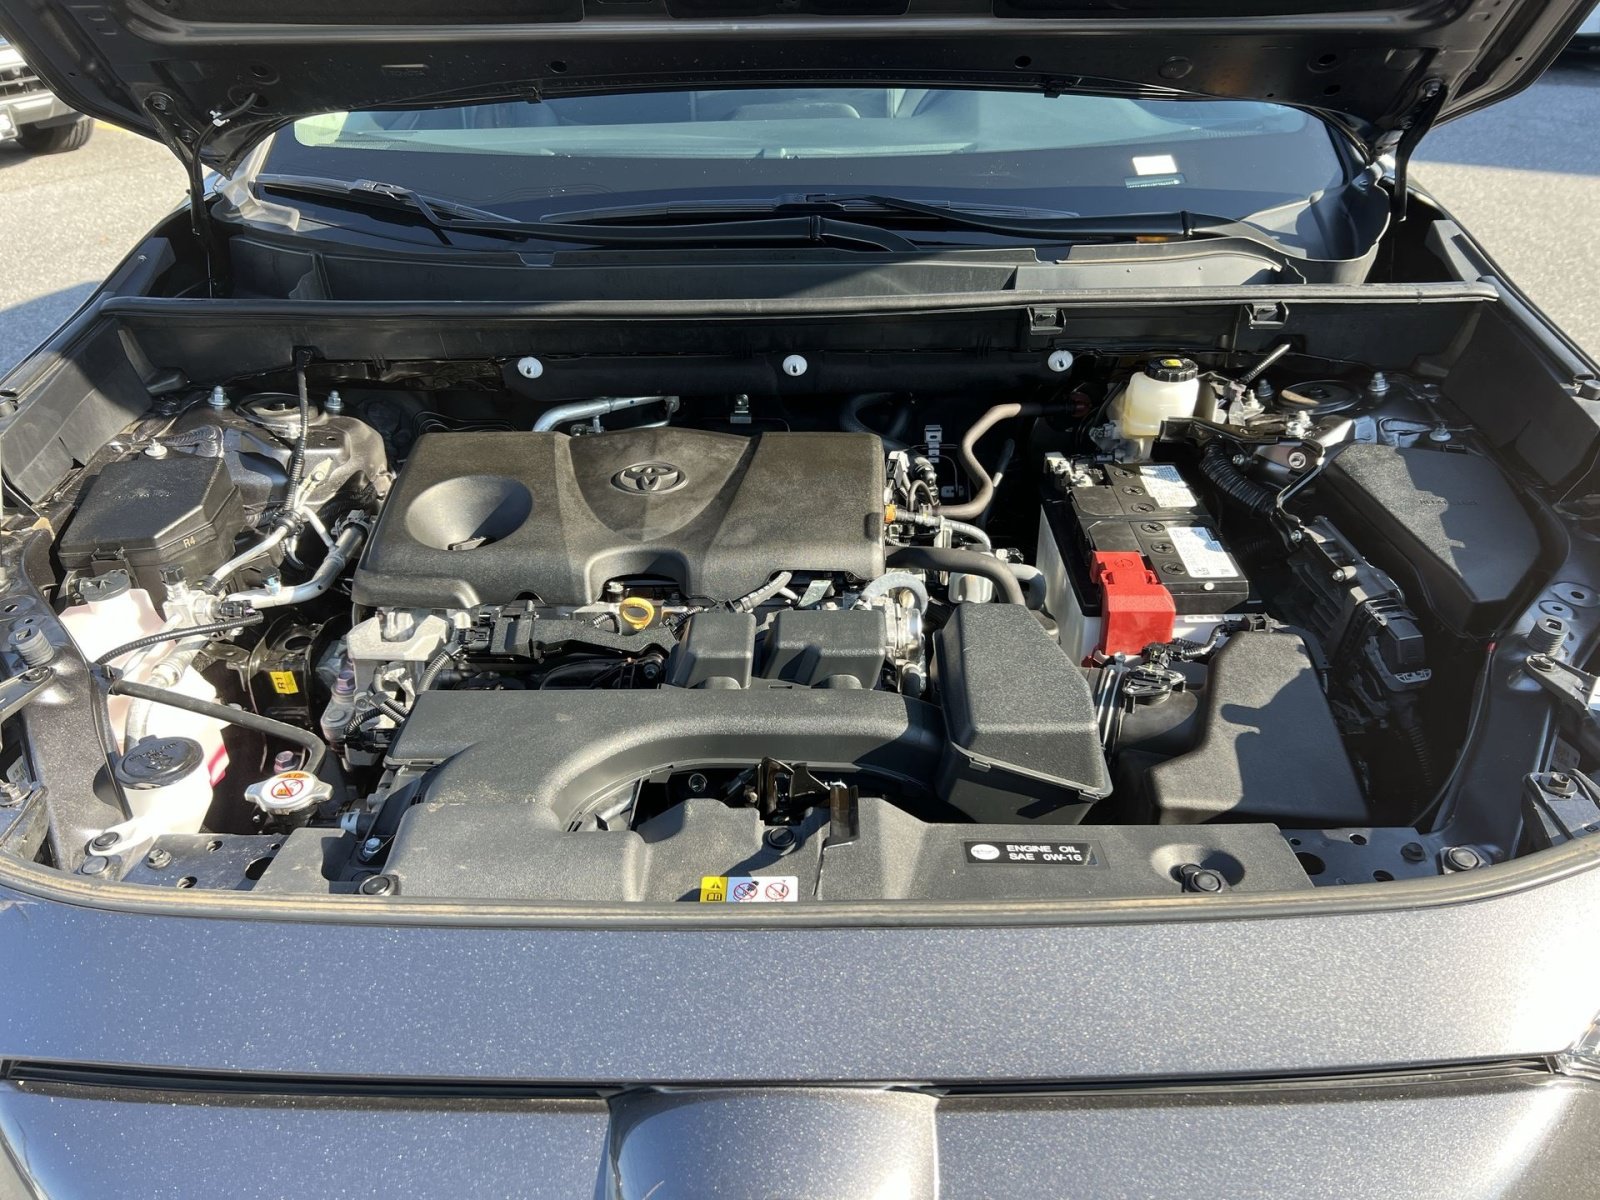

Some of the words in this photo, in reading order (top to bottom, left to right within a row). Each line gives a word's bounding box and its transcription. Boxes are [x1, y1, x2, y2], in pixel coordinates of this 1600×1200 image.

[183, 535, 196, 548] R4
[1006, 844, 1052, 853] ENGINE
[1008, 852, 1036, 861] SAE
[1042, 853, 1083, 862] 0W-16
